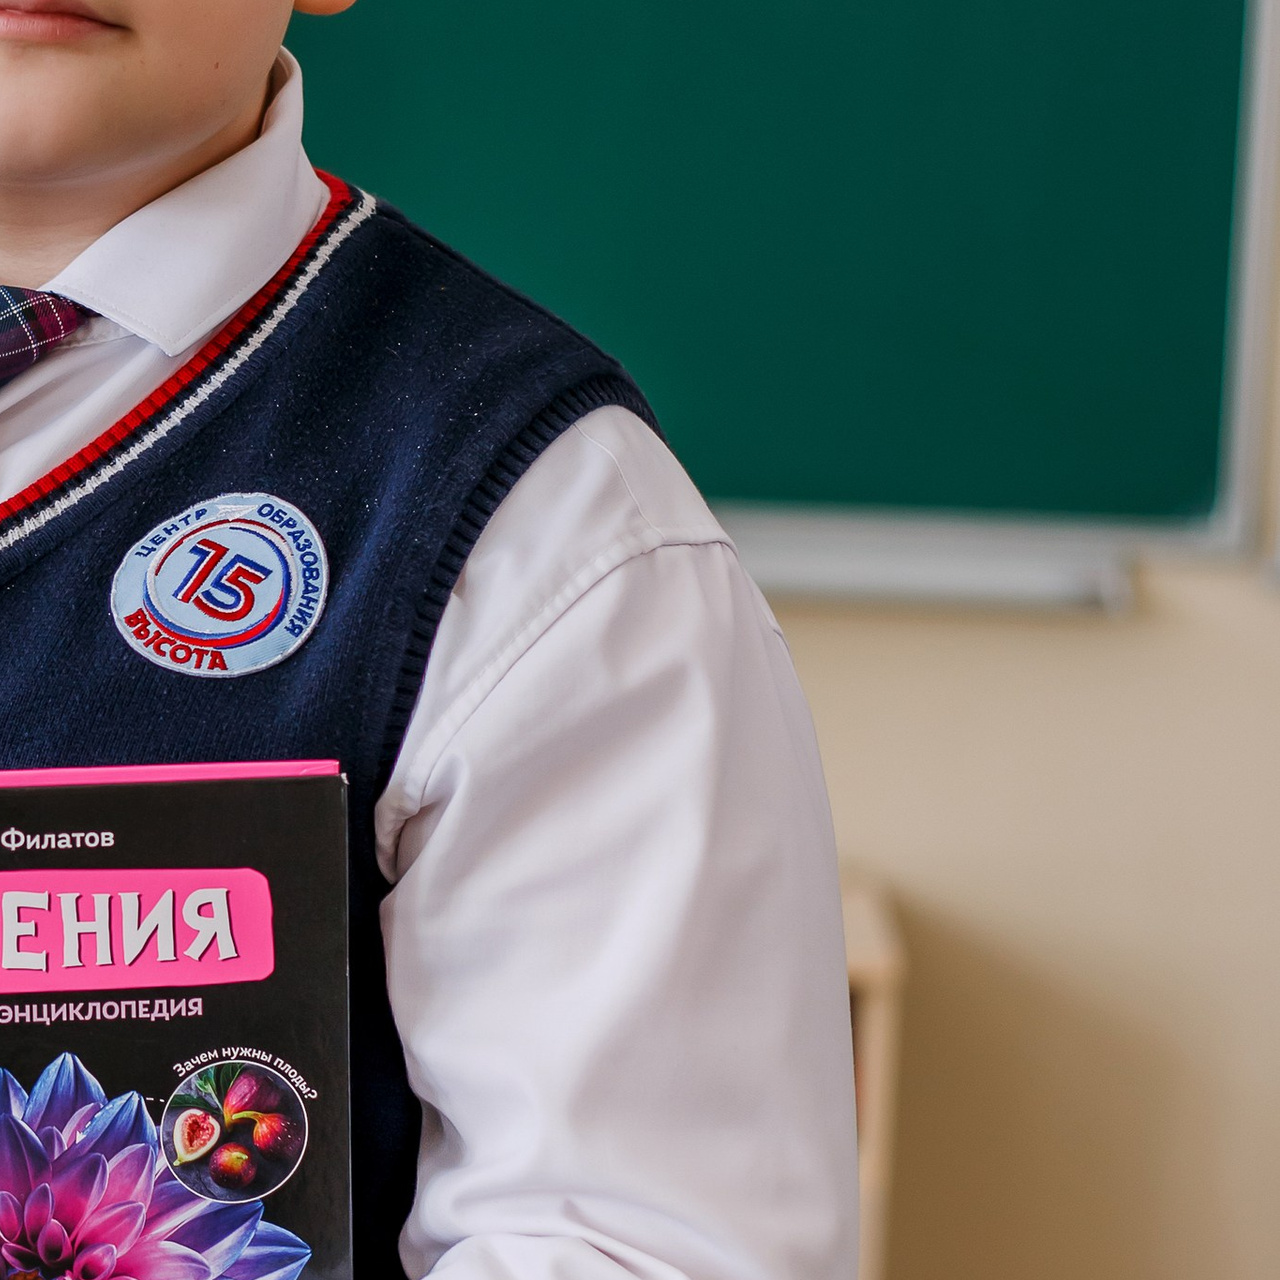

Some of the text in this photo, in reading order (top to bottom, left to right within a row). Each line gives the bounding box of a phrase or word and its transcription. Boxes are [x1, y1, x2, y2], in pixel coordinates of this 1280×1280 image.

[135, 502, 321, 638] ЦЕНТР ОБРАЗОВАНИЯ
[171, 538, 273, 622] 15
[124, 607, 229, 671] ВЫСОТА
[0, 827, 115, 852] Филатов
[173, 1046, 318, 1100] Зачем нужны плоды?
